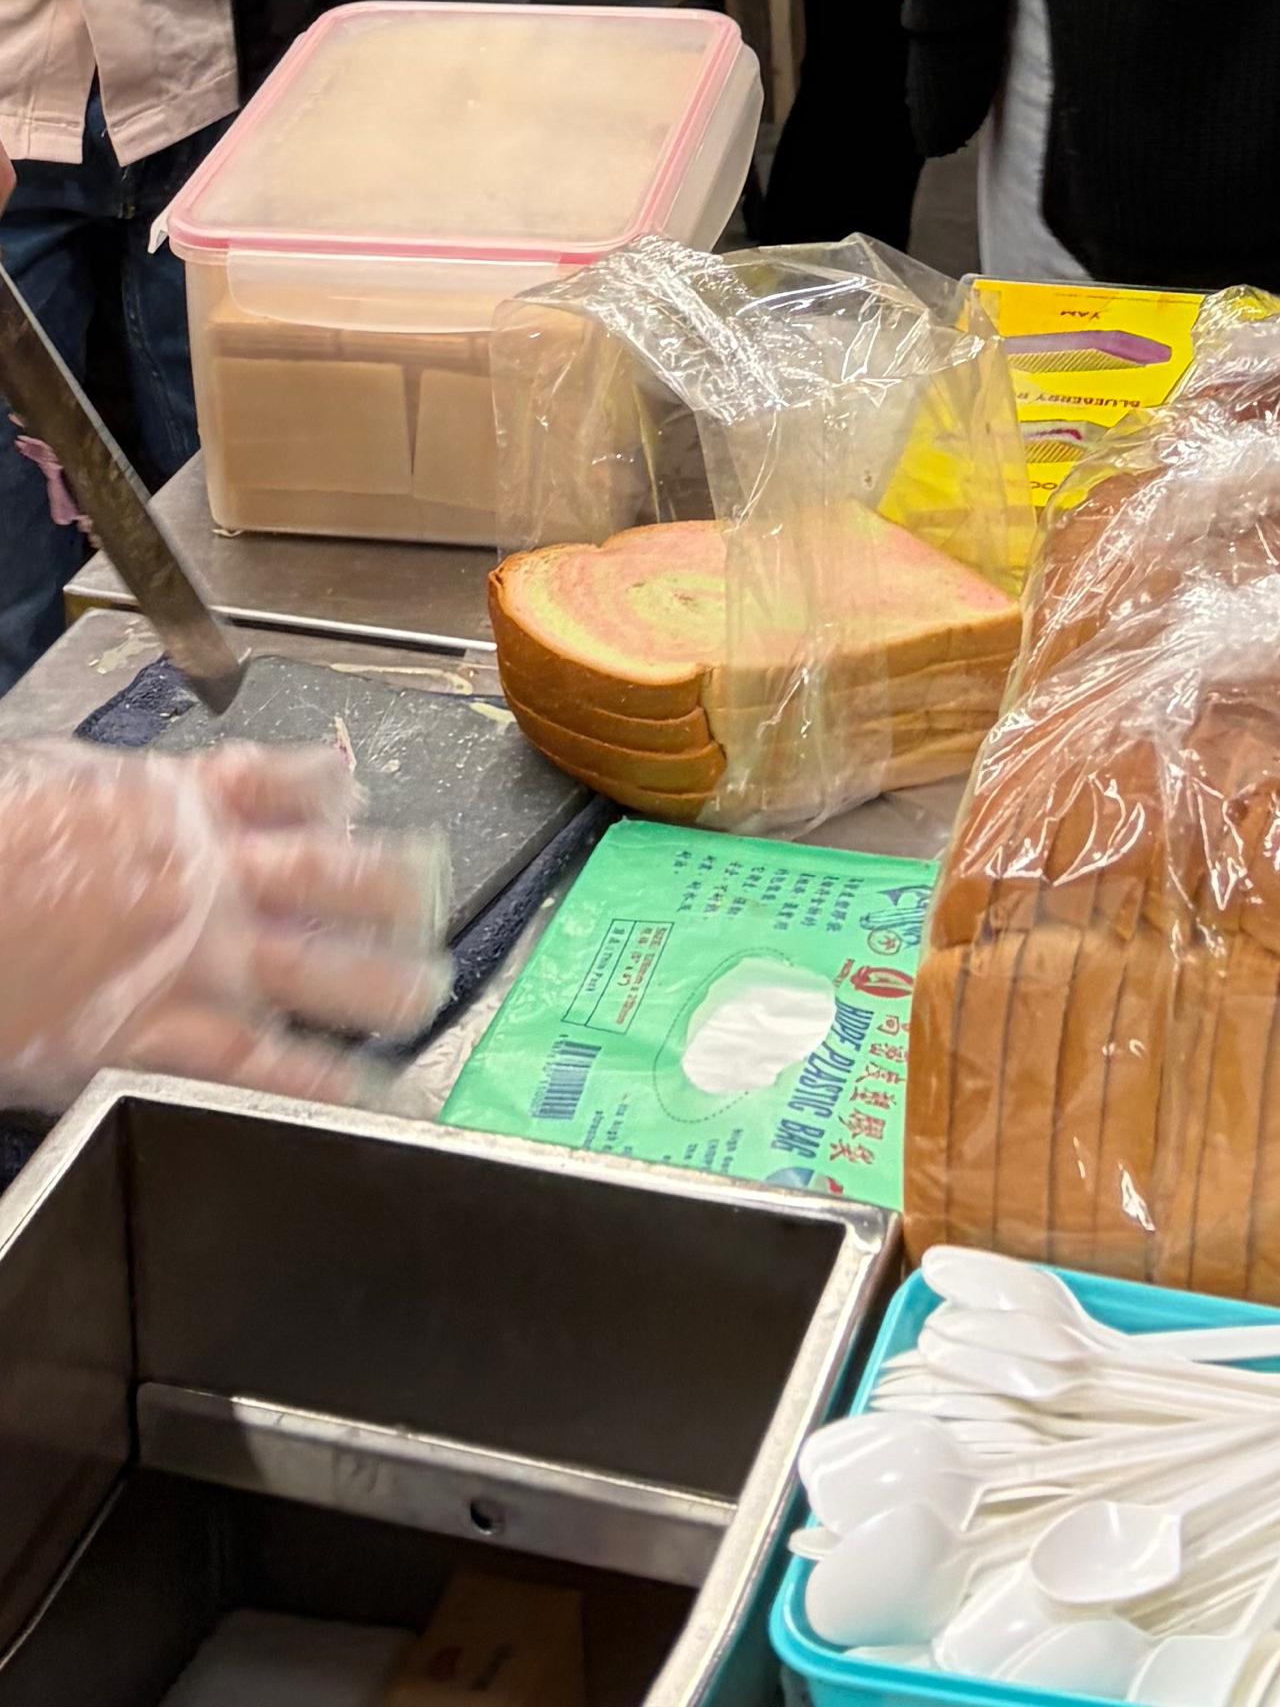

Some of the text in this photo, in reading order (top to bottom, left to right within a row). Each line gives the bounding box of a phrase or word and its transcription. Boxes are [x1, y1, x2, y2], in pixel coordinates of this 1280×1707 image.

[1060, 309, 1103, 321] YAM
[786, 1041, 855, 1117] PLASTIC
[769, 1119, 826, 1158] BAG
